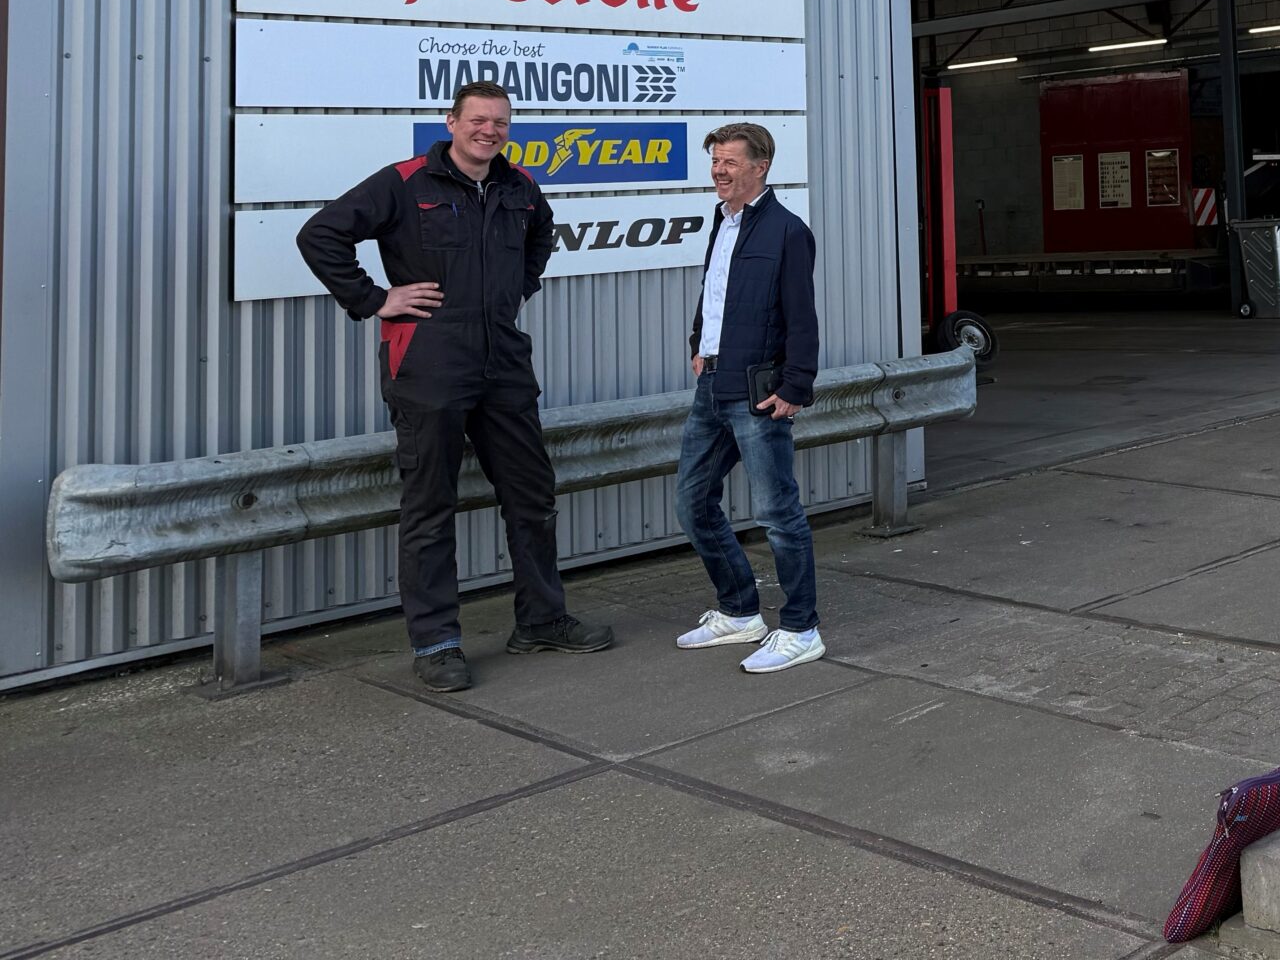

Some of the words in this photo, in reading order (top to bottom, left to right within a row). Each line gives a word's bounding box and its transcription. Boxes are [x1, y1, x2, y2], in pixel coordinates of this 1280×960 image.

[418, 37, 480, 56] Choose
[482, 39, 511, 57] the
[513, 41, 546, 57] best
[551, 216, 703, 253] NLOP
